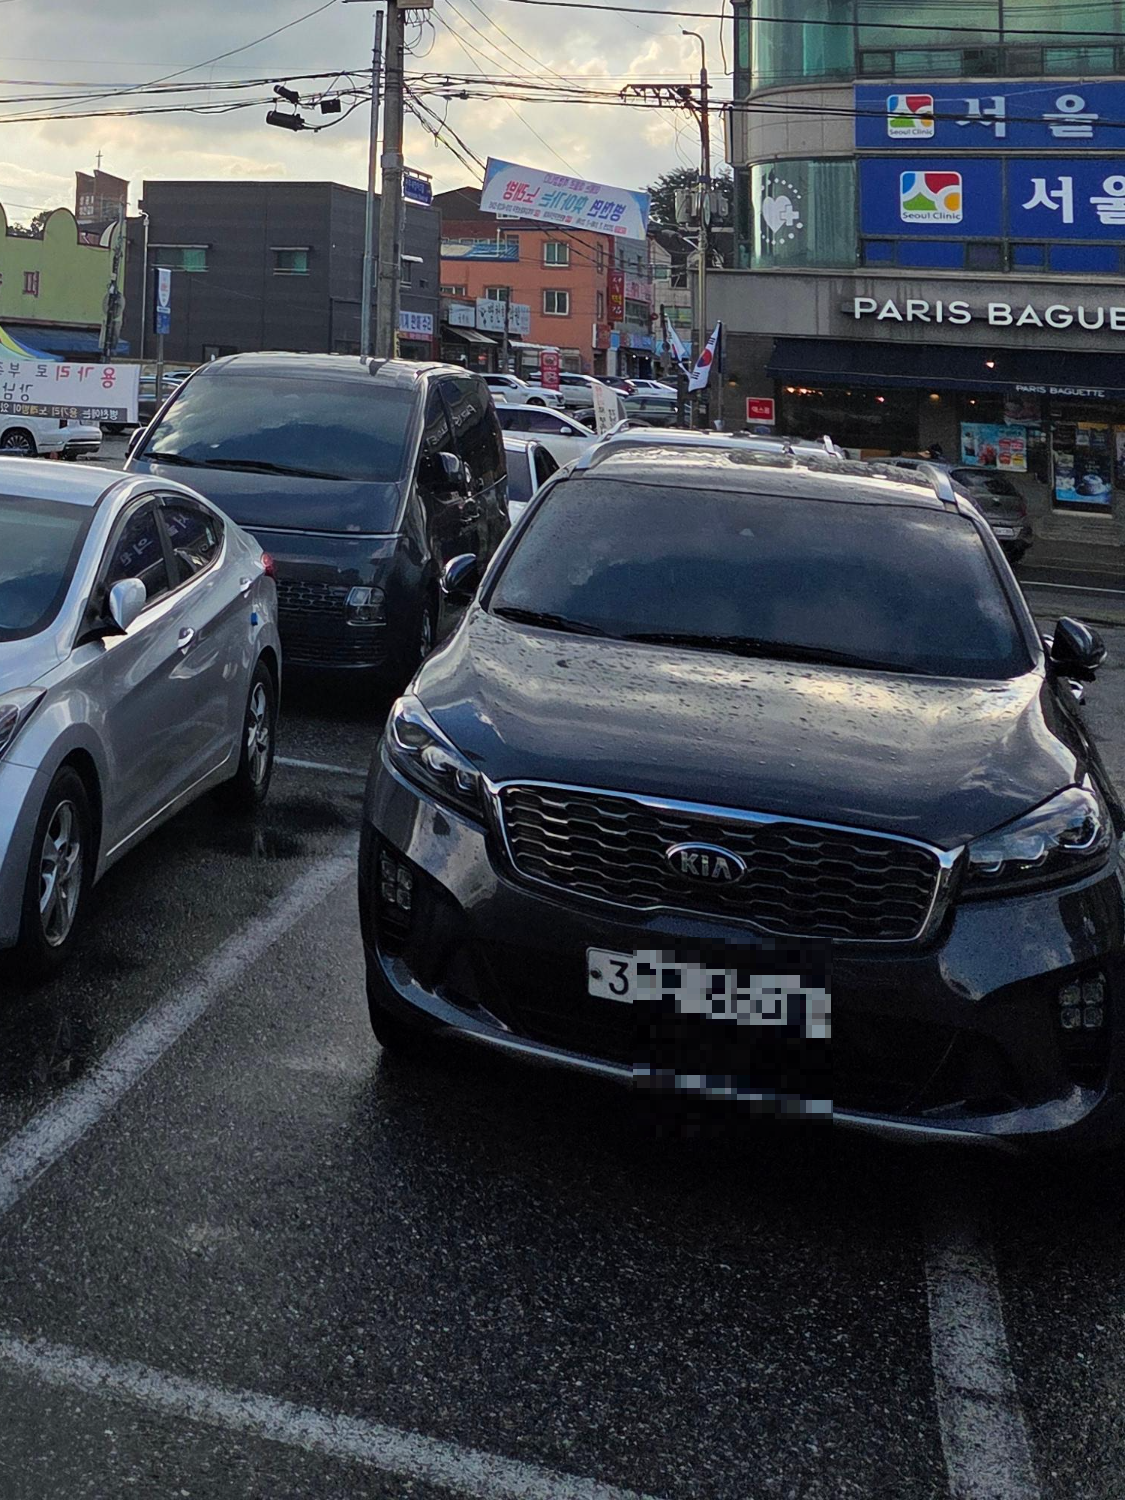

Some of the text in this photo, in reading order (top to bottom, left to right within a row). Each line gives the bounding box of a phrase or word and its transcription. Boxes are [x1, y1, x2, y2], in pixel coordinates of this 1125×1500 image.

[889, 128, 933, 136] Seoul Clinic
[902, 211, 961, 221] Seoul Clinic
[854, 297, 972, 325] PARIS
[1015, 384, 1106, 398] PARIS BAGUETTE
[680, 850, 732, 880] KIA
